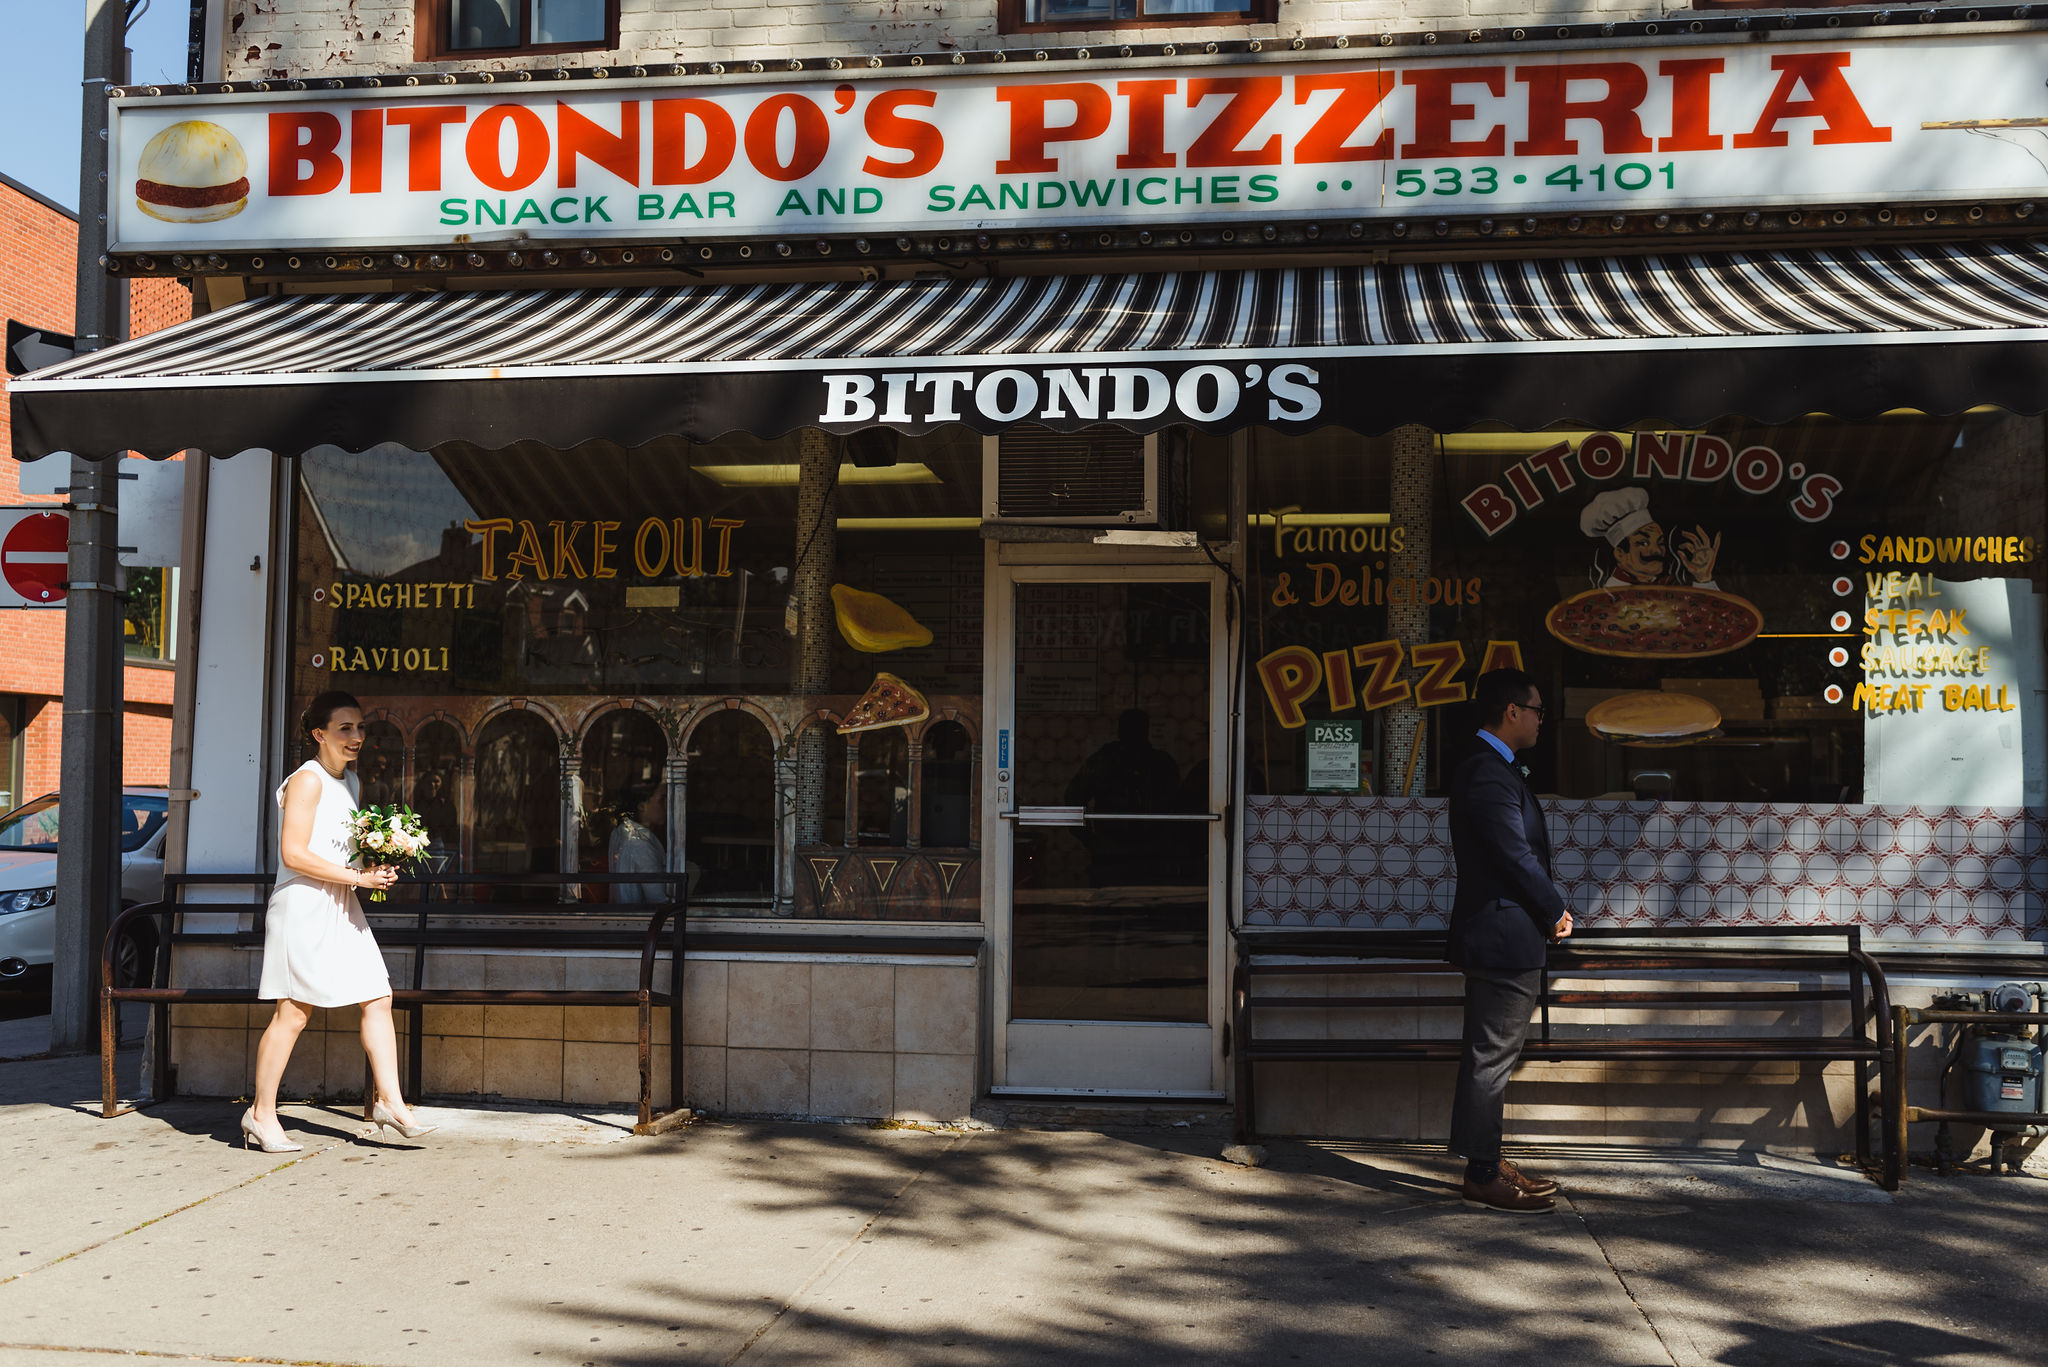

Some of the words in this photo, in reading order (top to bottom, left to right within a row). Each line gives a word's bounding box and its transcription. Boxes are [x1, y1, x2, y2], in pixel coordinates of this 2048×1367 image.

[268, 85, 944, 196] BITONDO'S
[996, 52, 1892, 175] PIZZERIA
[440, 195, 612, 226] SNACK
[638, 191, 736, 222] BAR
[776, 187, 884, 217] AND
[927, 174, 1280, 213] SANDWICHES
[818, 363, 1322, 424] BITONDO'S
[1460, 430, 1843, 537] BITONDO'S
[463, 517, 621, 581] TAKE
[634, 517, 745, 577] OUT
[1268, 506, 1405, 558] Famous
[329, 581, 475, 610] SPAGHETTI
[1271, 572, 1299, 607] &
[1306, 561, 1481, 607] Delicious
[1865, 571, 1942, 598] VEAL
[1861, 607, 1971, 636] STEAK
[329, 646, 449, 672] RAVIOLI
[1858, 641, 1992, 672] SAUSAGE
[1852, 681, 1932, 711] MEAT
[1944, 683, 2016, 712] BALL
[1314, 726, 1354, 742] PASS
